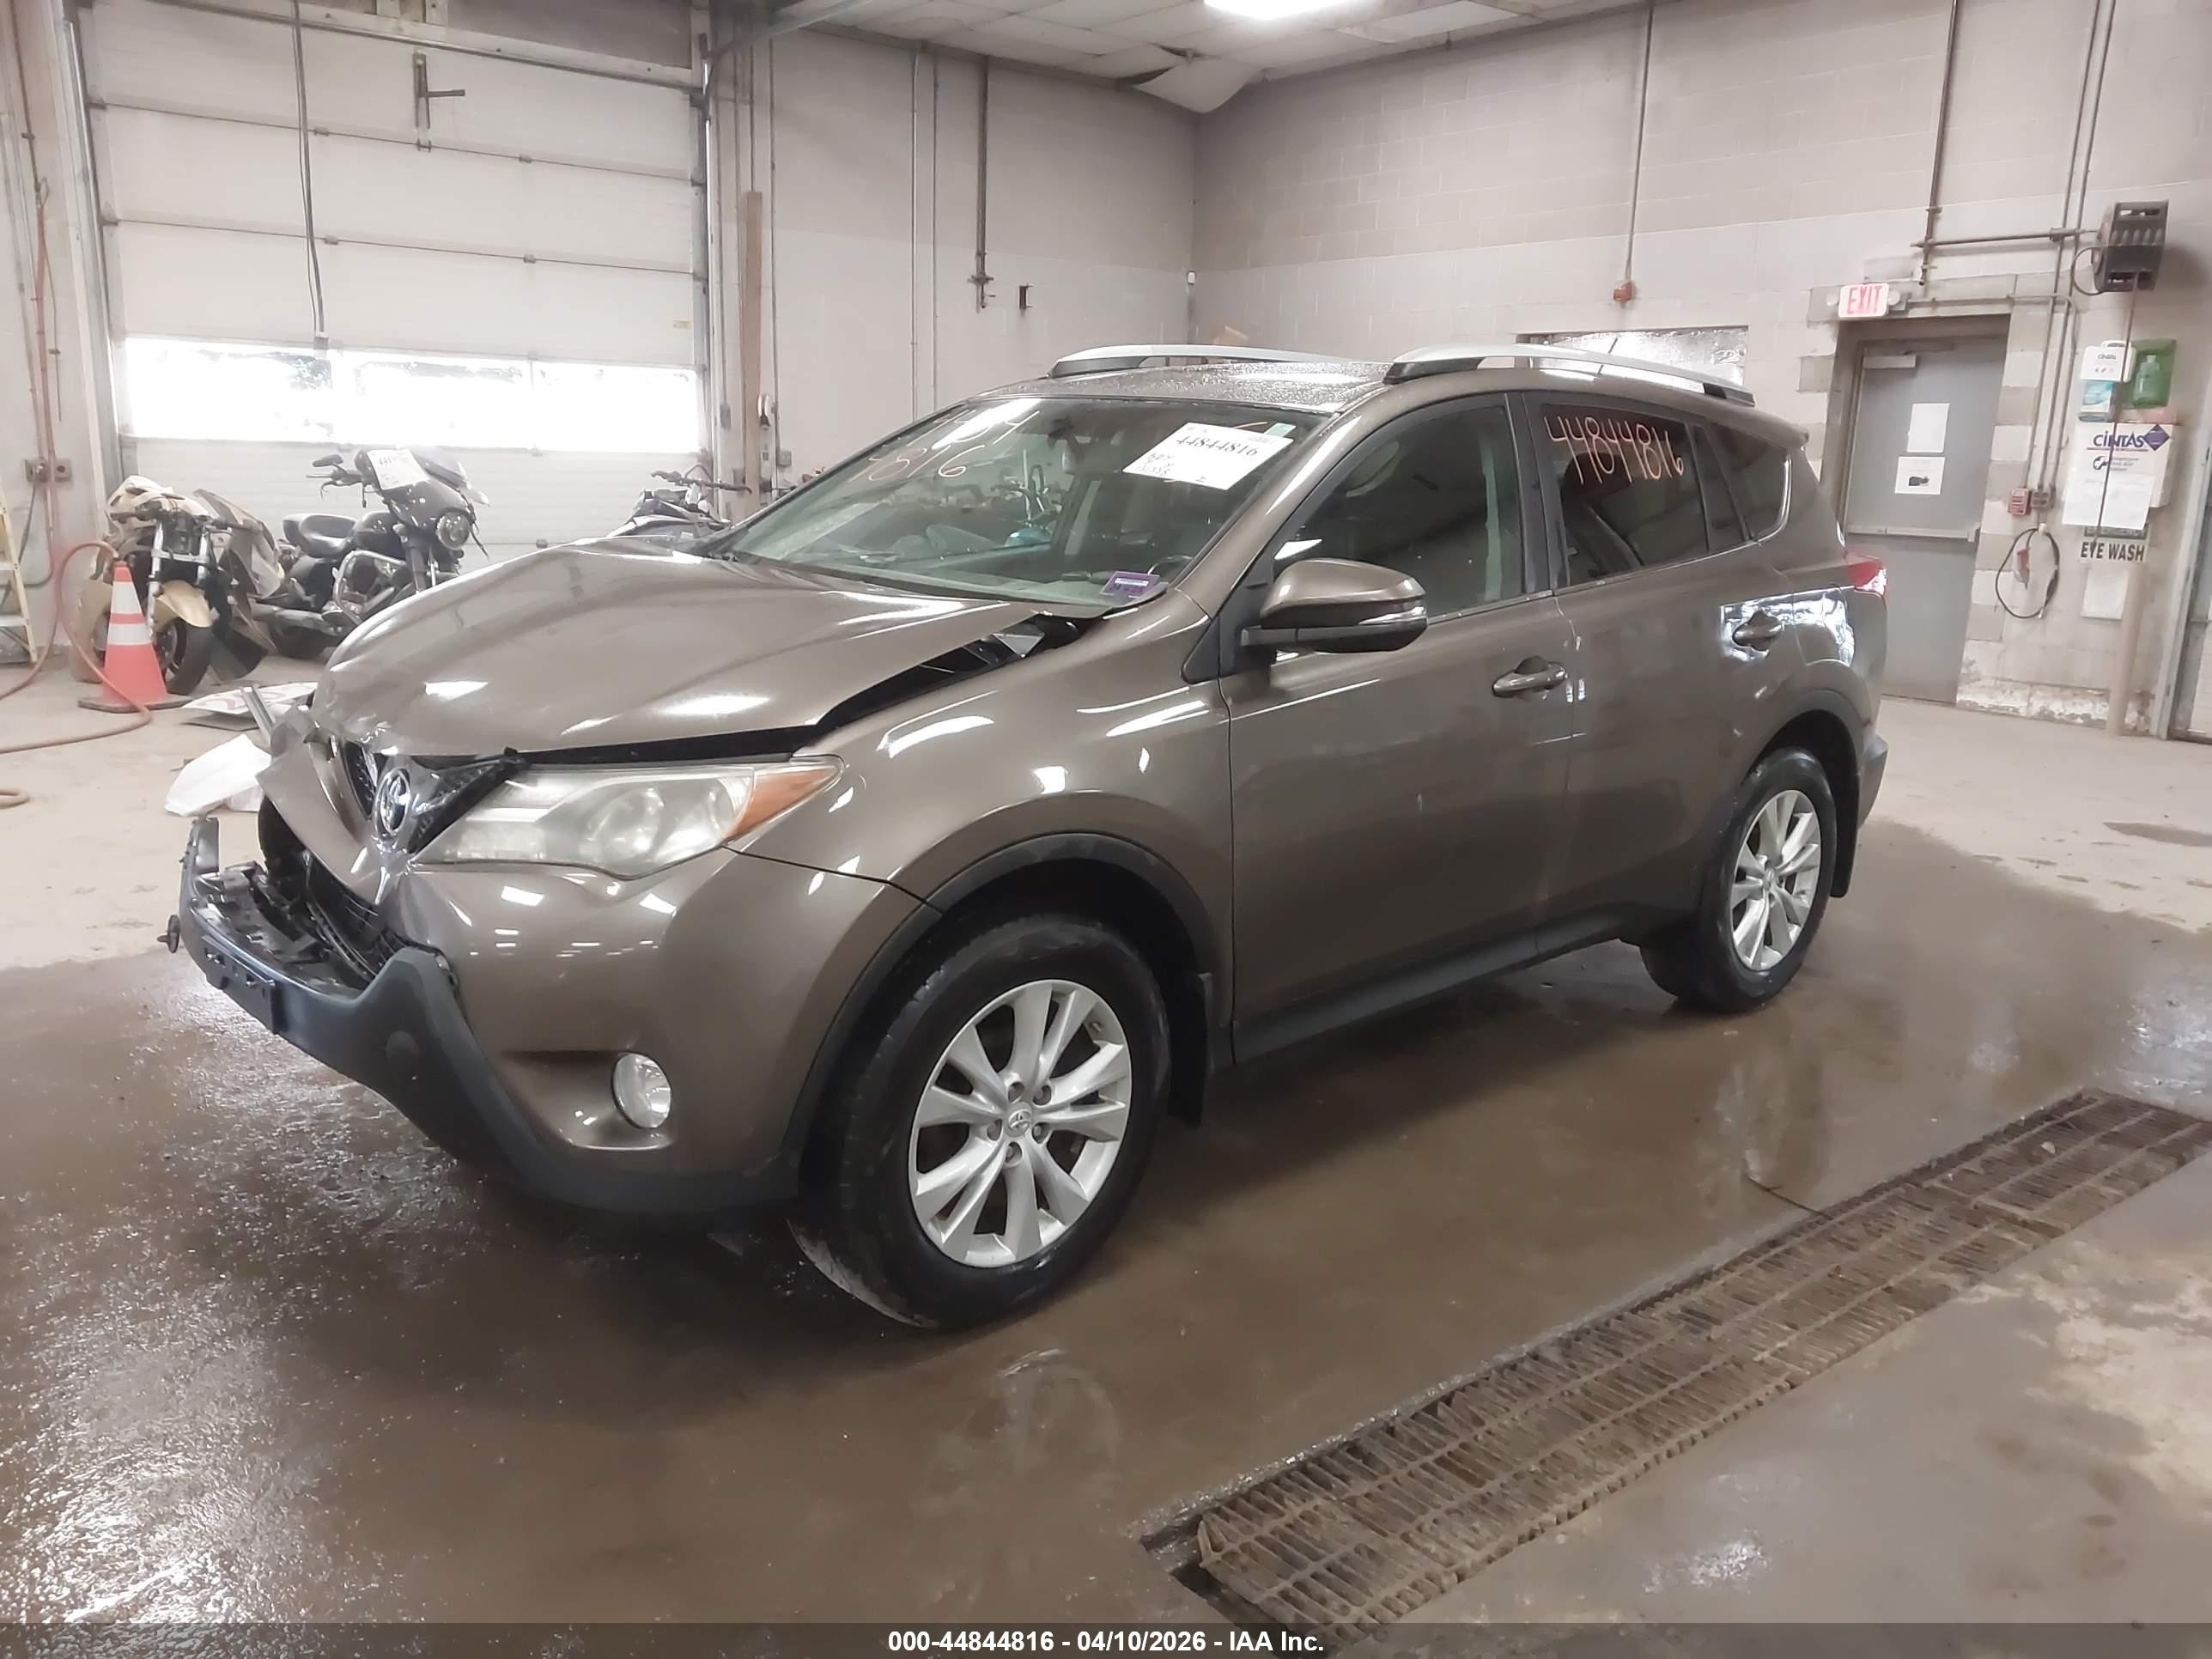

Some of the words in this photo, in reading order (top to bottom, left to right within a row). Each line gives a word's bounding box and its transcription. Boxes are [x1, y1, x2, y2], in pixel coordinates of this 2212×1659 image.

[1846, 285, 1883, 315] EXIT
[1176, 435, 1259, 458] 44844816
[1544, 416, 1685, 485] 44844816
[2093, 430, 2145, 448] CINTAS
[2081, 541, 2106, 560] EYE
[2108, 543, 2145, 562] WASH
